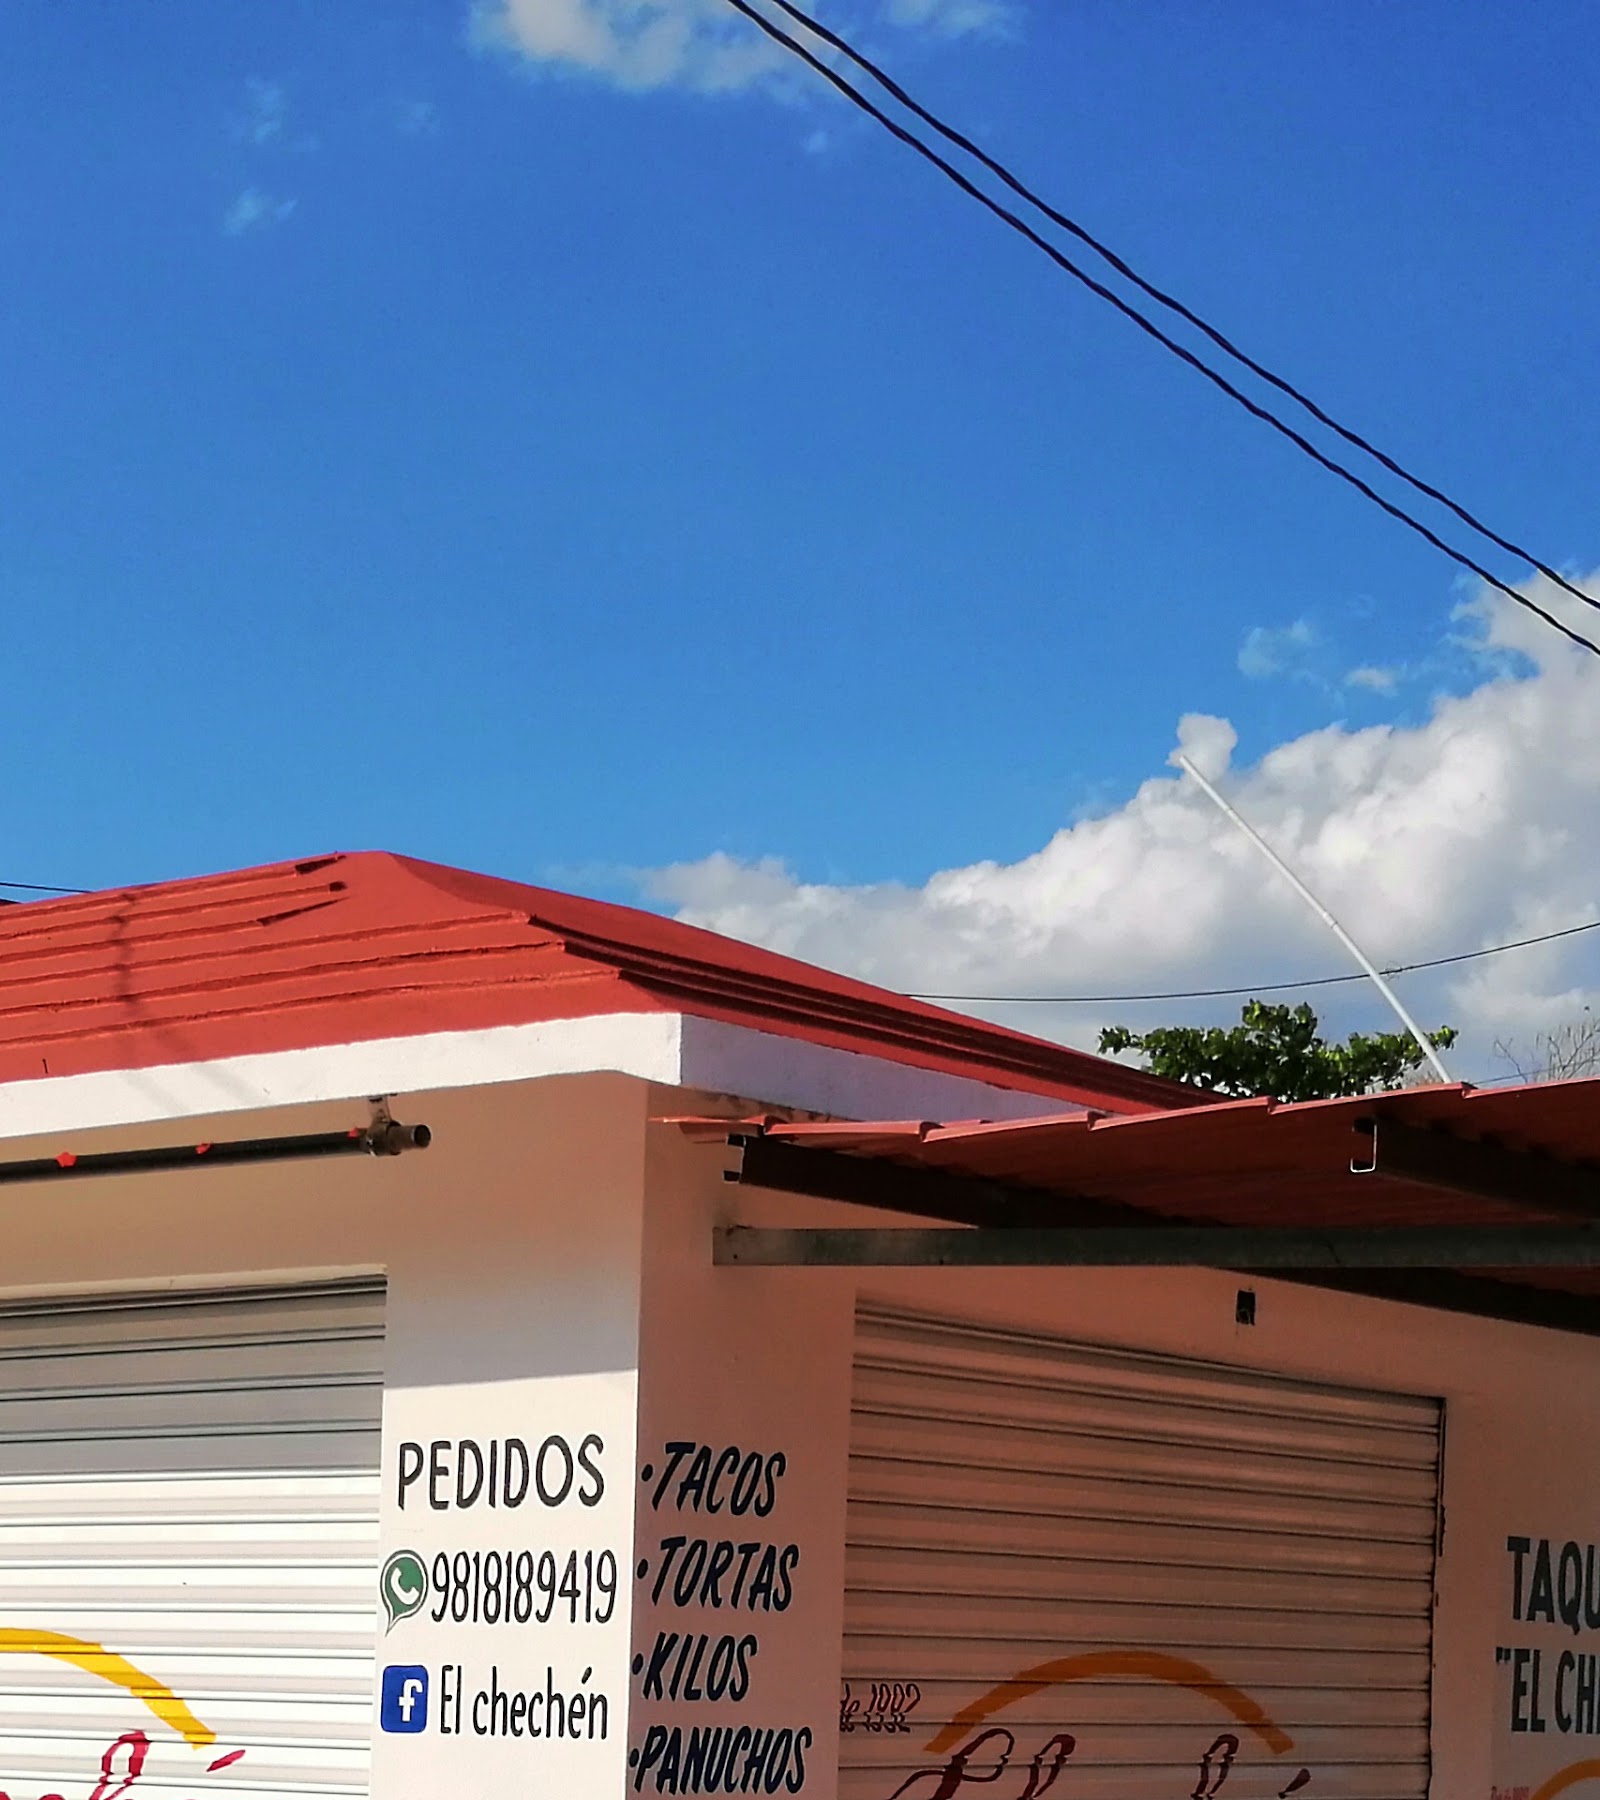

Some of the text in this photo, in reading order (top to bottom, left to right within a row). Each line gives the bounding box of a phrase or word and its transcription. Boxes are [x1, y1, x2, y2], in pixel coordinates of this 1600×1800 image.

[397, 1434, 606, 1511] PEDIDOS
[650, 1441, 788, 1517] TACOS
[430, 1548, 619, 1625] 9818189419
[650, 1535, 800, 1612] TORTAS
[439, 1664, 462, 1736] El
[471, 1664, 609, 1740] chechén
[642, 1631, 758, 1702] KILOS
[633, 1725, 813, 1796] PANUCHOS
